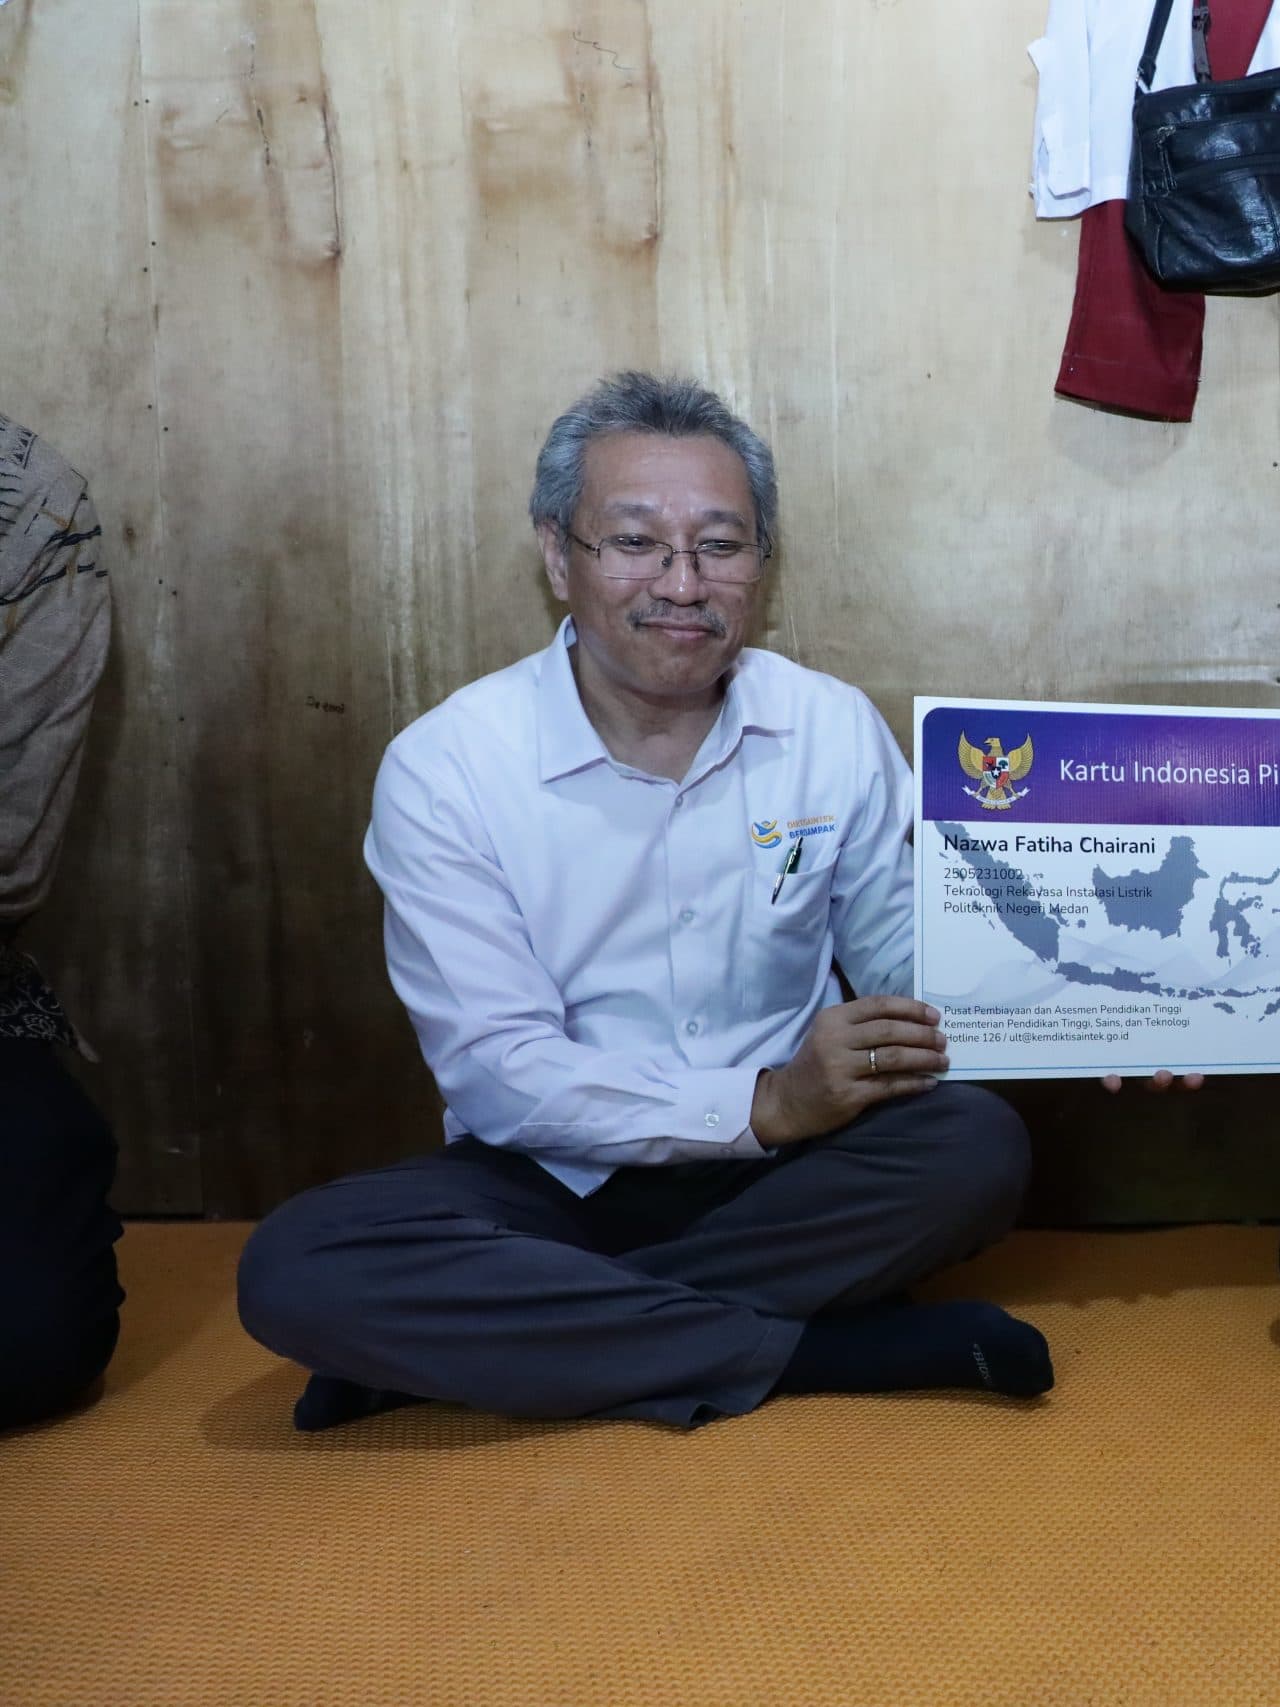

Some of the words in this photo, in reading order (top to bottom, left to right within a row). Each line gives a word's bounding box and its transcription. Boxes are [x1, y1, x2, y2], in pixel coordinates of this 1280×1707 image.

[1060, 759, 1125, 782] Kartu
[1134, 761, 1250, 785] Indonesia
[944, 835, 1008, 851] Nazwa
[1015, 836, 1072, 852] Fatiha
[1080, 837, 1155, 853] Chairani
[944, 868, 1023, 879] 2505231002
[944, 884, 1003, 899] Teknologi
[1006, 885, 1063, 899] Rekayasa
[1066, 886, 1114, 898] Instalasi
[1118, 886, 1152, 898] Listrik
[944, 902, 1002, 913] Politeknik
[1006, 903, 1045, 916] Negeri
[1049, 903, 1089, 914] Medan
[944, 1005, 971, 1015] Pusat
[974, 1005, 1031, 1016] Pembiayaan
[1034, 1005, 1052, 1015] dan
[1054, 1005, 1097, 1015] Asesmen
[1100, 1004, 1151, 1014] Pendidikan
[1153, 1004, 1182, 1015] Tinggi
[944, 1019, 1004, 1029] Kementerian
[1007, 1019, 1059, 1028] Pendidikan
[1061, 1018, 1093, 1029] Tinggi,
[1095, 1018, 1123, 1028] Sains,
[1125, 1017, 1142, 1027] dan
[1145, 1017, 1190, 1028] Teknologi
[945, 1032, 980, 1043] Hotline
[983, 1032, 1001, 1042] 126
[1009, 1031, 1129, 1044] ult@kemdiktisaintek.go.id
